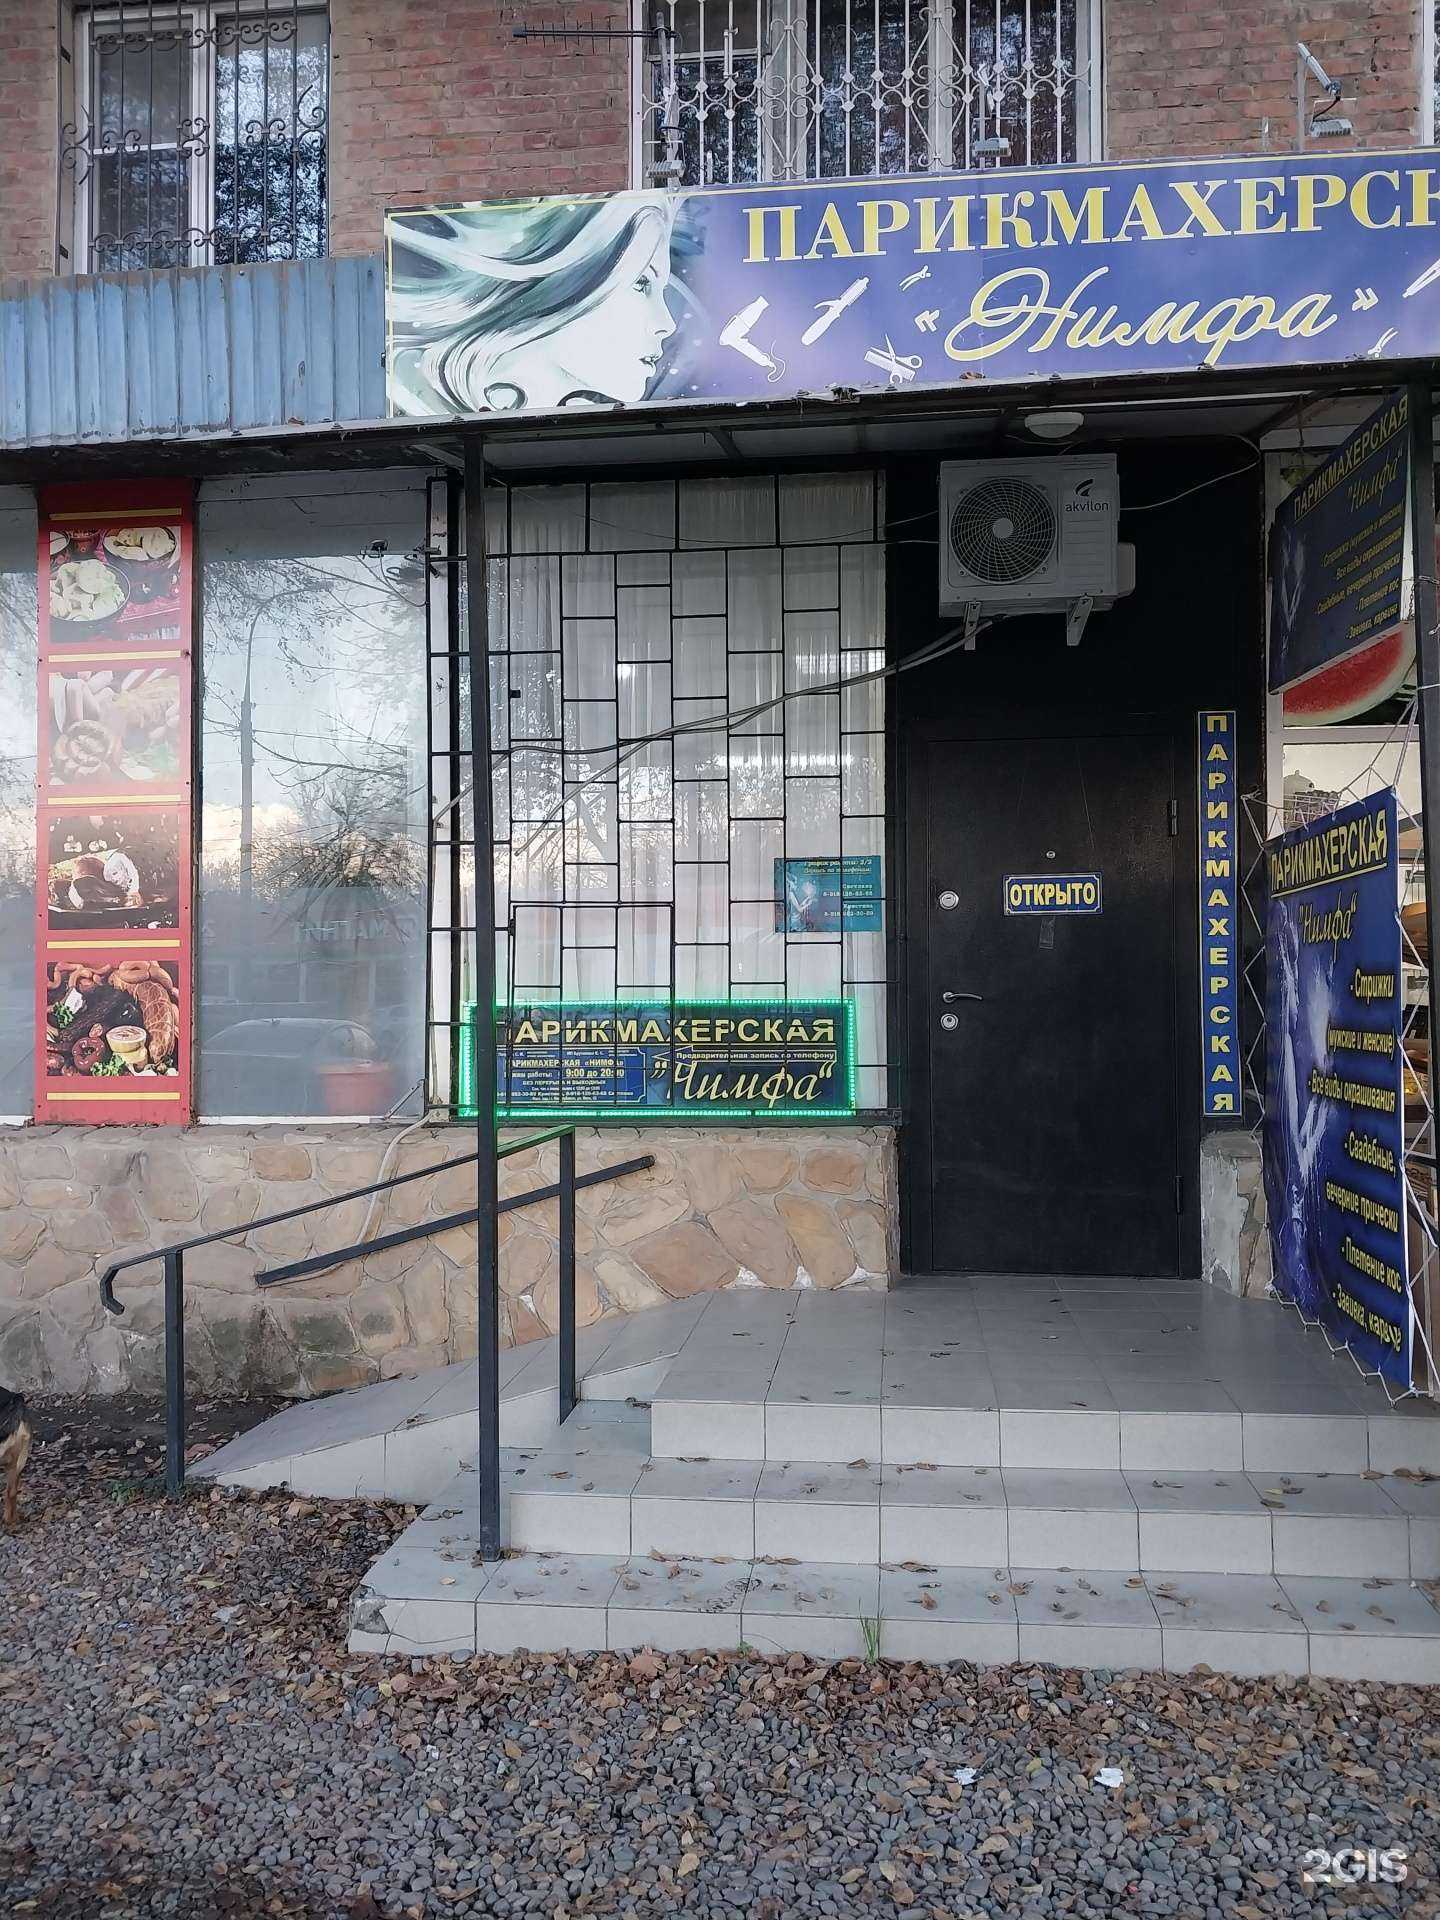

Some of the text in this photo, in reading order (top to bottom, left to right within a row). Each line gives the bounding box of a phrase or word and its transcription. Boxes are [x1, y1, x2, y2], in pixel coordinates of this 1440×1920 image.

[1293, 393, 1408, 521] ПАРИКМАХЕРСКАЯ
[1065, 501, 1109, 512] akvilon
[1271, 808, 1388, 892] ПАРИКМАХЕРСКАЯ
[1010, 882, 1096, 907] ОТКРЫТО
[1206, 714, 1234, 1111] ПАРИКМАХЕРСКАЯ
[1355, 968, 1394, 1005] Стрижки
[496, 1018, 835, 1043] АРИКМАХЕРСКАЯ
[1363, 1026, 1395, 1061] женские)
[566, 1068, 584, 1078] 9:00
[586, 1069, 598, 1079] до
[793, 1051, 835, 1061] телефону
[1312, 1069, 1396, 1113] Все виды окрашивания
[1349, 1130, 1396, 1178] Свадебные,
[1326, 1181, 1399, 1233] вечерние прически
[1345, 1236, 1402, 1294] Плетение кос
